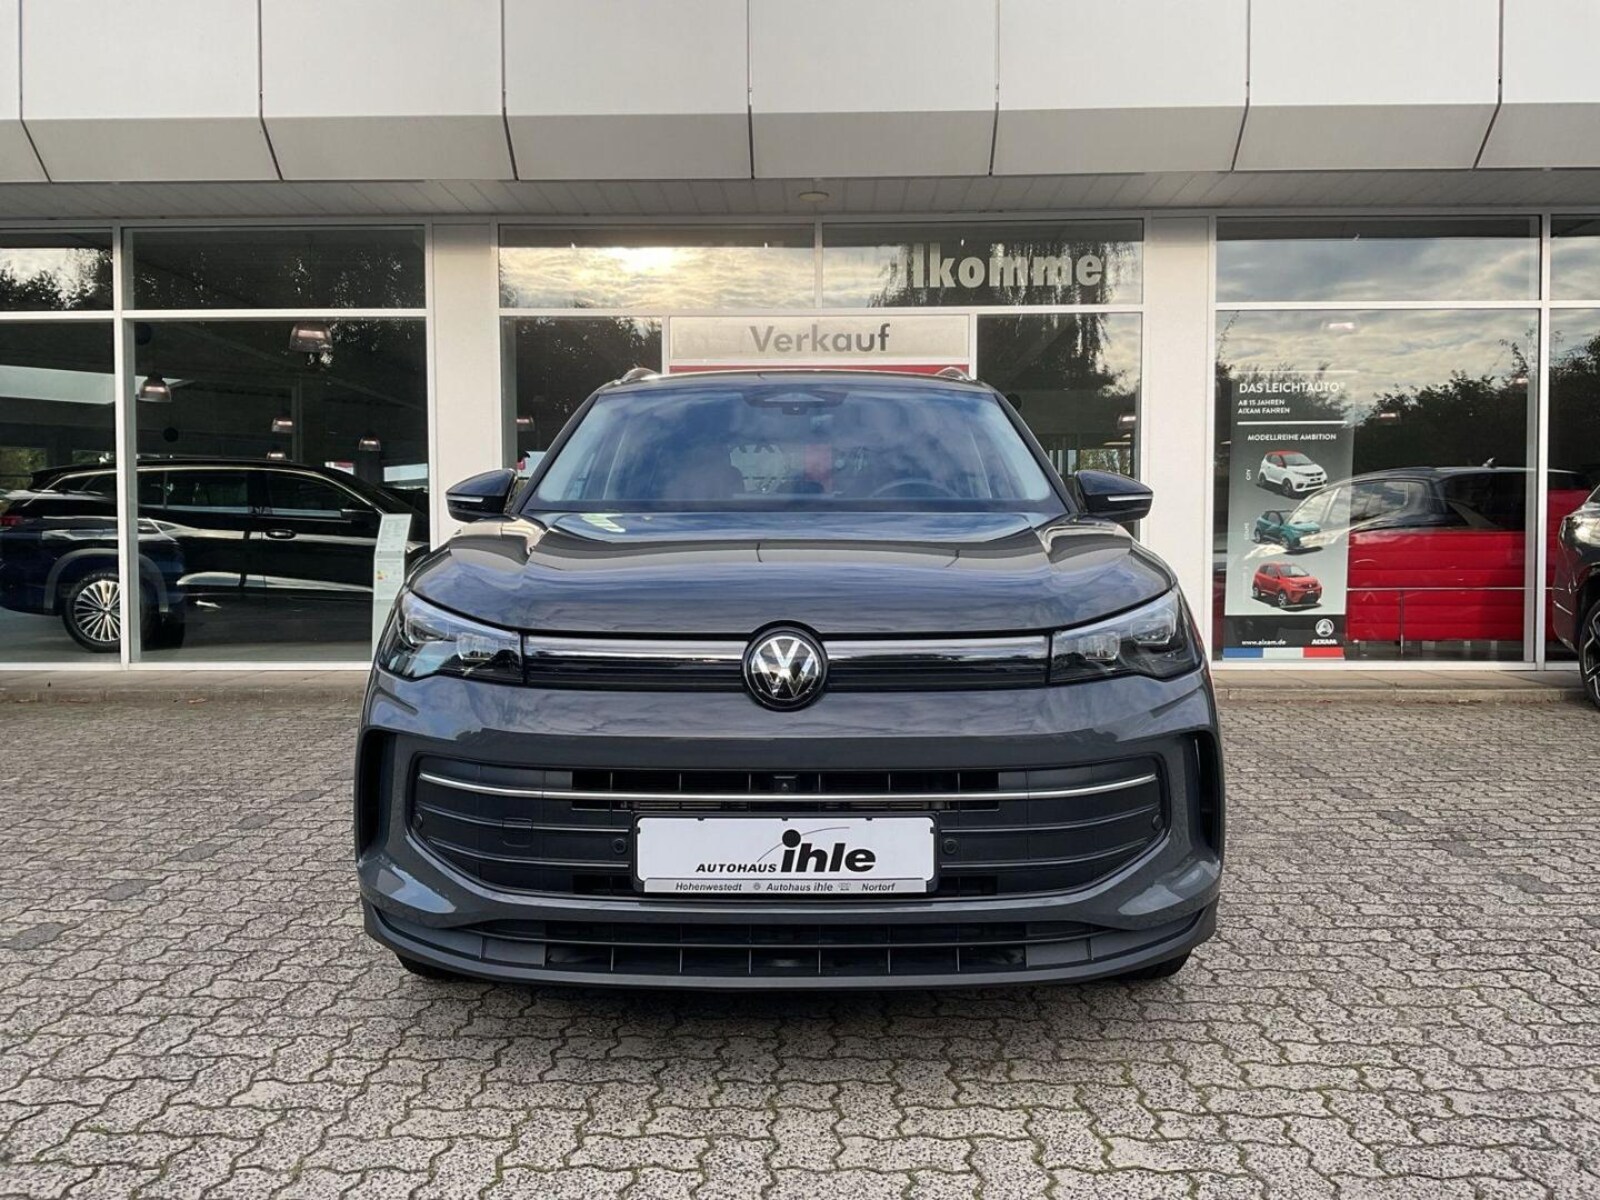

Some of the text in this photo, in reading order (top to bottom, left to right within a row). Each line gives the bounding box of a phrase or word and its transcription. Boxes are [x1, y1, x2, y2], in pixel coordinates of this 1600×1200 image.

[750, 322, 891, 352] Verkauf
[1239, 381, 1340, 394] DAS LEICHTAUTO
[1238, 399, 1248, 407] AB
[1237, 407, 1261, 415] AIXAM
[1247, 433, 1337, 441] MODELLREIHE AMBITION
[1241, 638, 1287, 646] www.aixam.de
[695, 829, 876, 873] AUTOHAUS ihle
[675, 882, 895, 892] Hohenwestedt Autohaus ihle Nortorf
